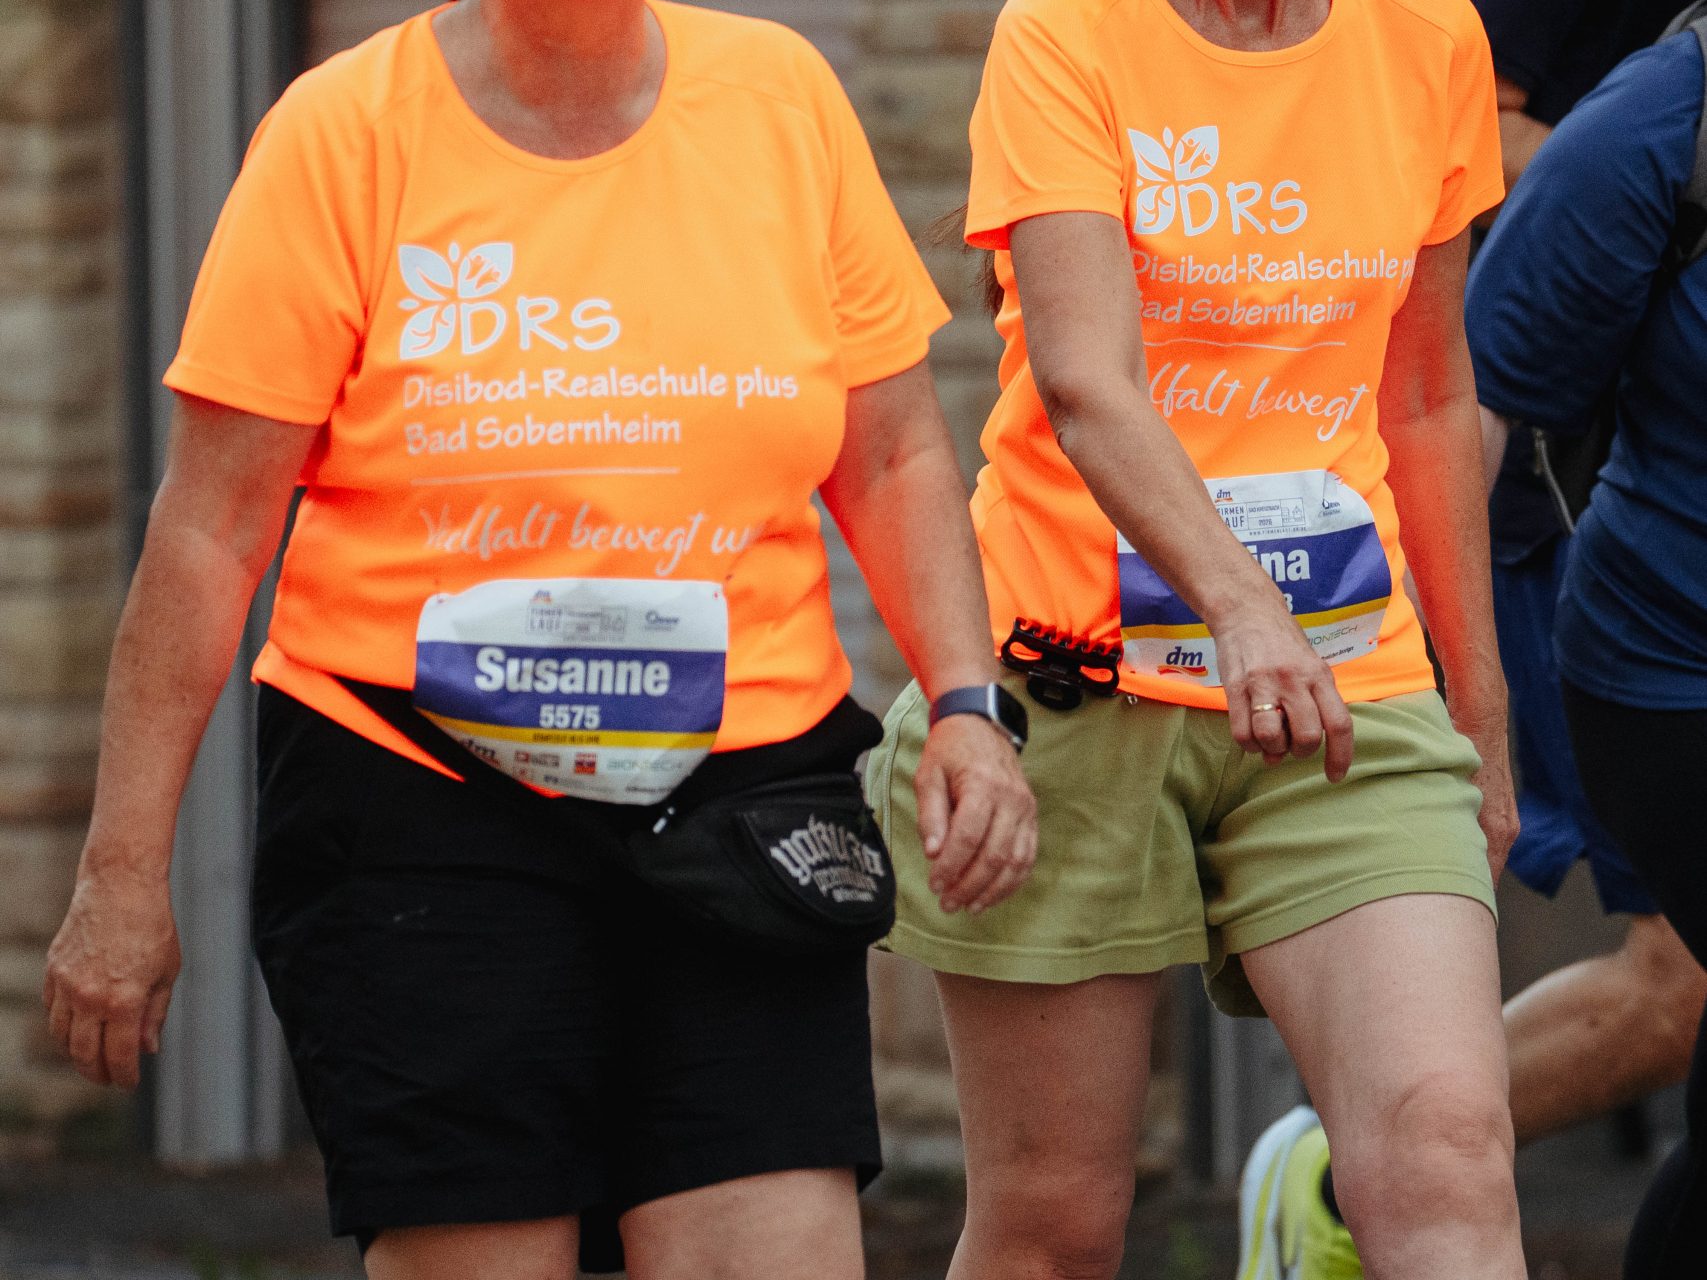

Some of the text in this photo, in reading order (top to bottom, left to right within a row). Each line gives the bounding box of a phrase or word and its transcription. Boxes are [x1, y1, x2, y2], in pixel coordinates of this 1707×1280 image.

[1179, 180, 1308, 236] DRS
[460, 296, 621, 355] DRS
[1137, 291, 1356, 326] ad Sobernheim
[403, 365, 798, 408] Disibod-Realschule plus
[1150, 362, 1245, 417] lfalt
[404, 412, 680, 454] Bad Sobernheim
[569, 501, 707, 577] bewegt
[1225, 516, 1245, 528] AUF
[1166, 646, 1204, 666] dm
[1307, 624, 1358, 646] IONTECH
[474, 646, 671, 697] Susanne
[538, 704, 600, 730] 5575
